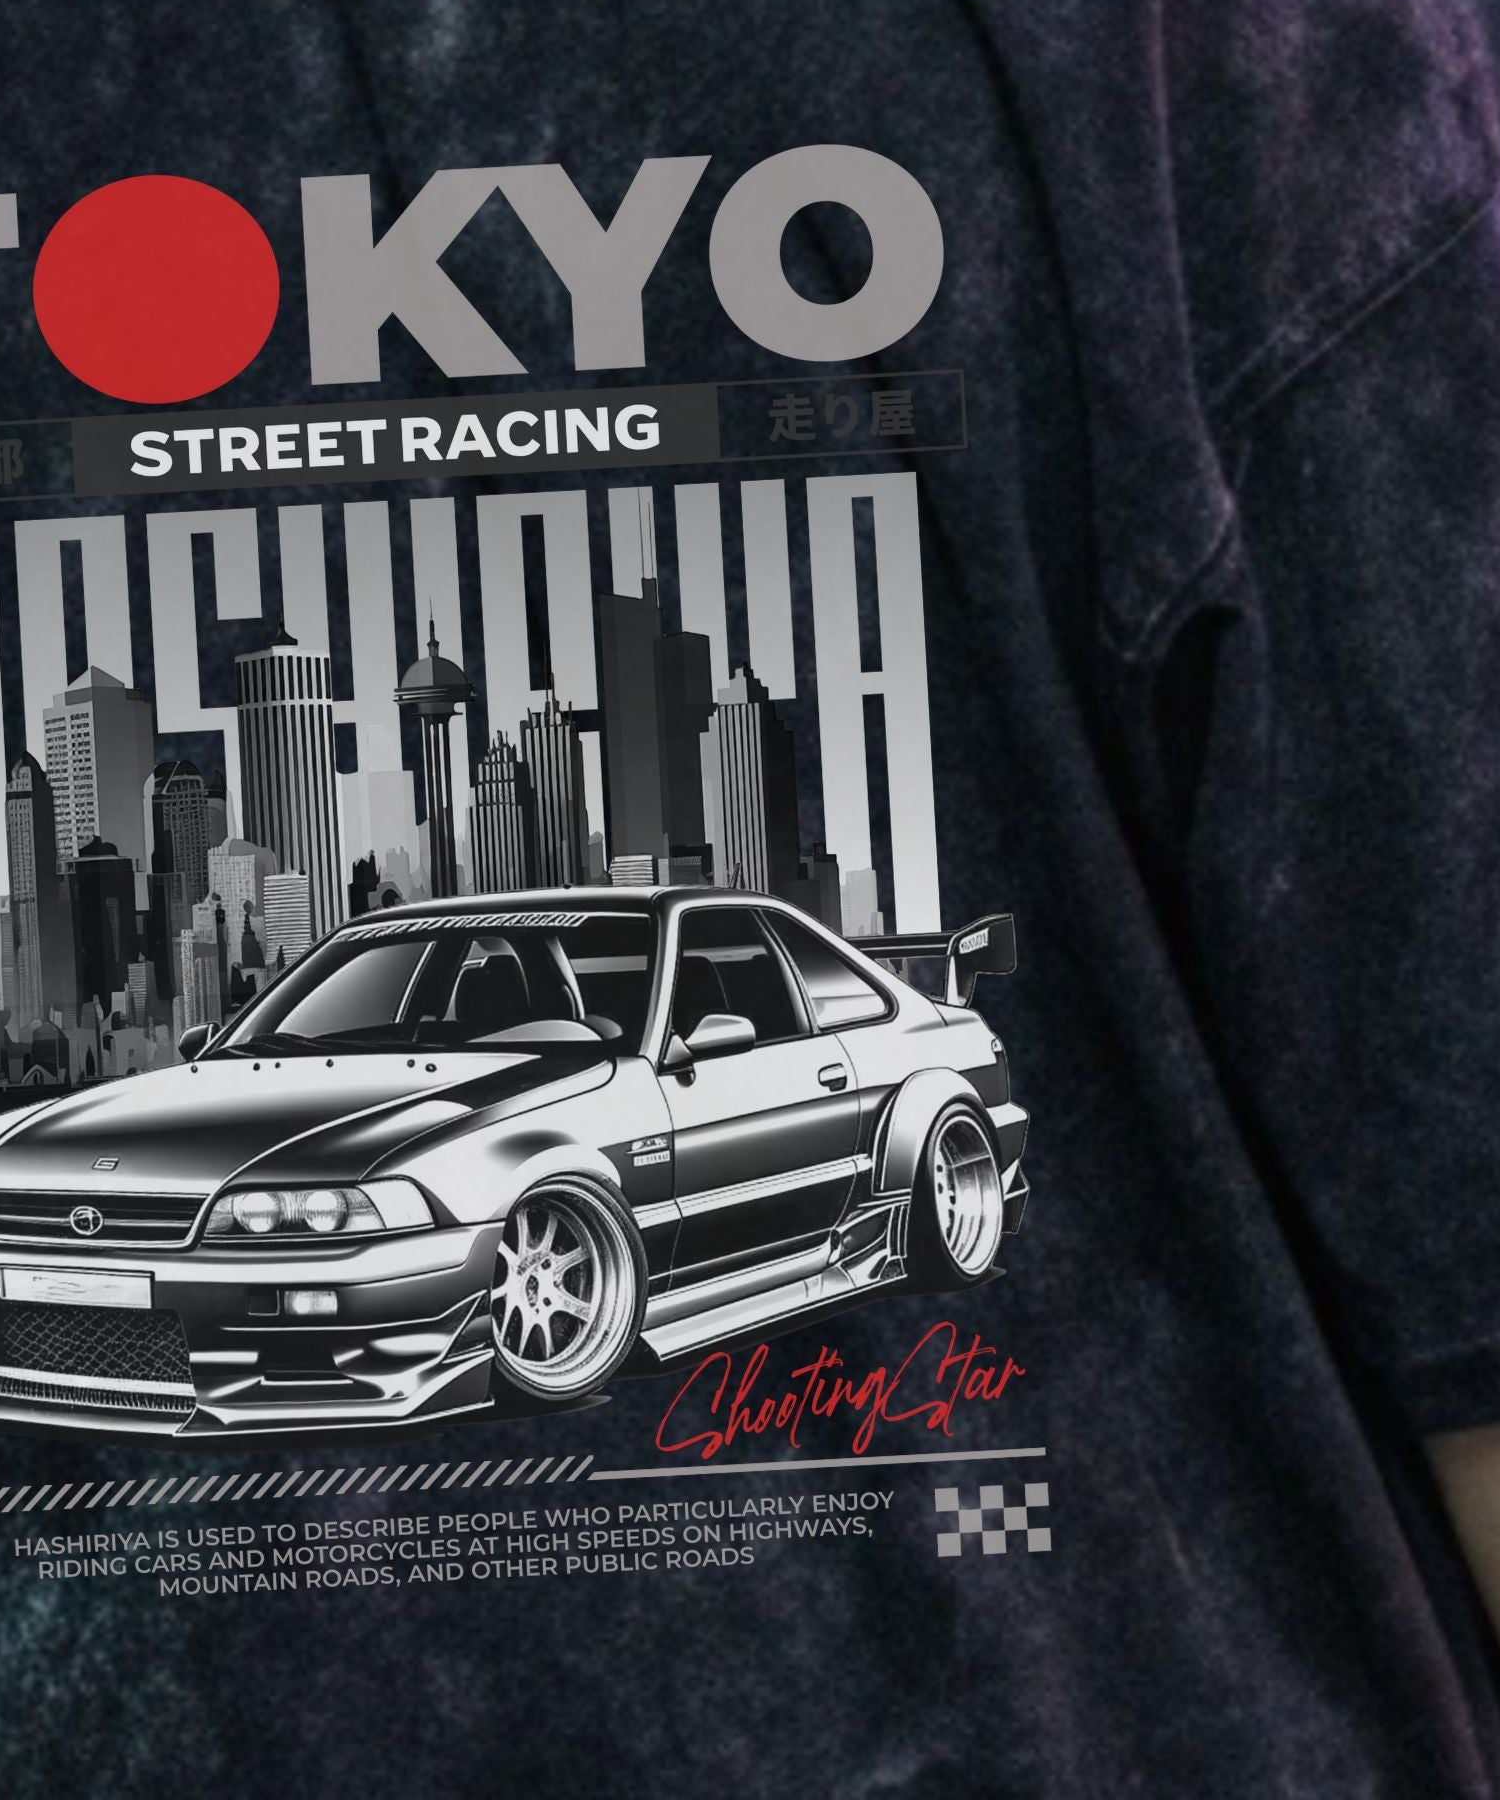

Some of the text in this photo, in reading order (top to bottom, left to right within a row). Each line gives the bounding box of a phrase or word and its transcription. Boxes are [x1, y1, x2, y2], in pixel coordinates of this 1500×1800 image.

[129, 403, 662, 478] STREET RACING
[768, 390, 915, 442] 走り屋
[14, 1490, 894, 1557] HASHIRIYA IS USED TO DESCRIBE PEOPLE WHO PARTICULARLY ENJOY
[38, 1516, 873, 1580] RIDING CARS AND MOTORCYCLES AT HIGH SPEEDS ON HIGHWAYS,
[159, 1546, 755, 1597] MOUNTAIN ROADS, AND OTHER PUBLIC ROADS
